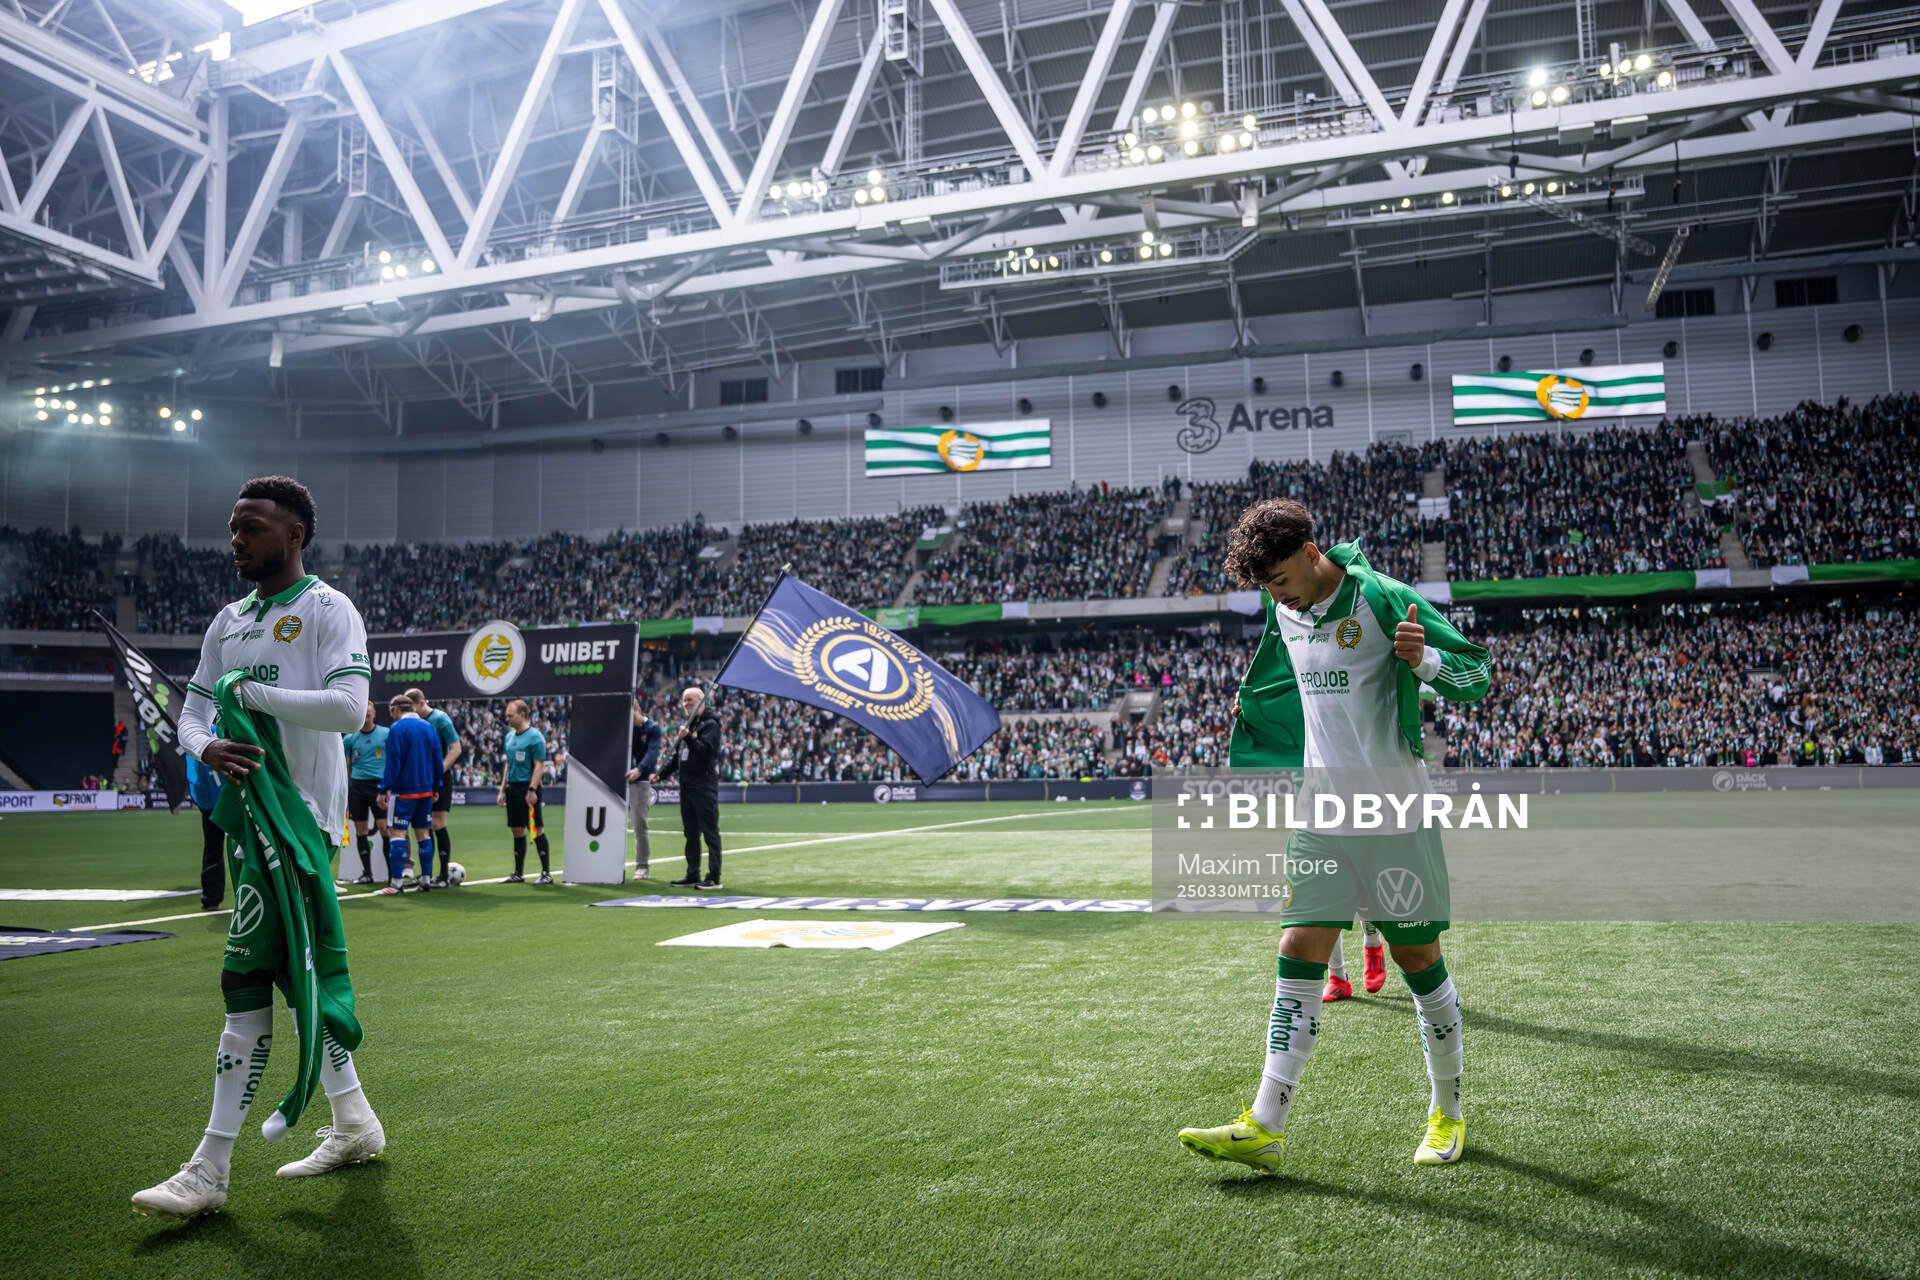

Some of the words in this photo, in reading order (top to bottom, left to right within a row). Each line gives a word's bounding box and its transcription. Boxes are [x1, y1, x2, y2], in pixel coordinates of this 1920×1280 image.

[1175, 396, 1222, 454] 3
[1227, 402, 1334, 434] Arena
[374, 649, 448, 671] UNIBET
[541, 640, 620, 664] UNIBET
[1300, 671, 1349, 687] PROJOB
[815, 682, 865, 709] UNIBET
[1736, 772, 1766, 782] DÄCK
[69, 793, 98, 804] FRONT
[892, 786, 916, 794] DÄCK
[1182, 779, 1297, 799] STOCKHO
[586, 807, 607, 836] U
